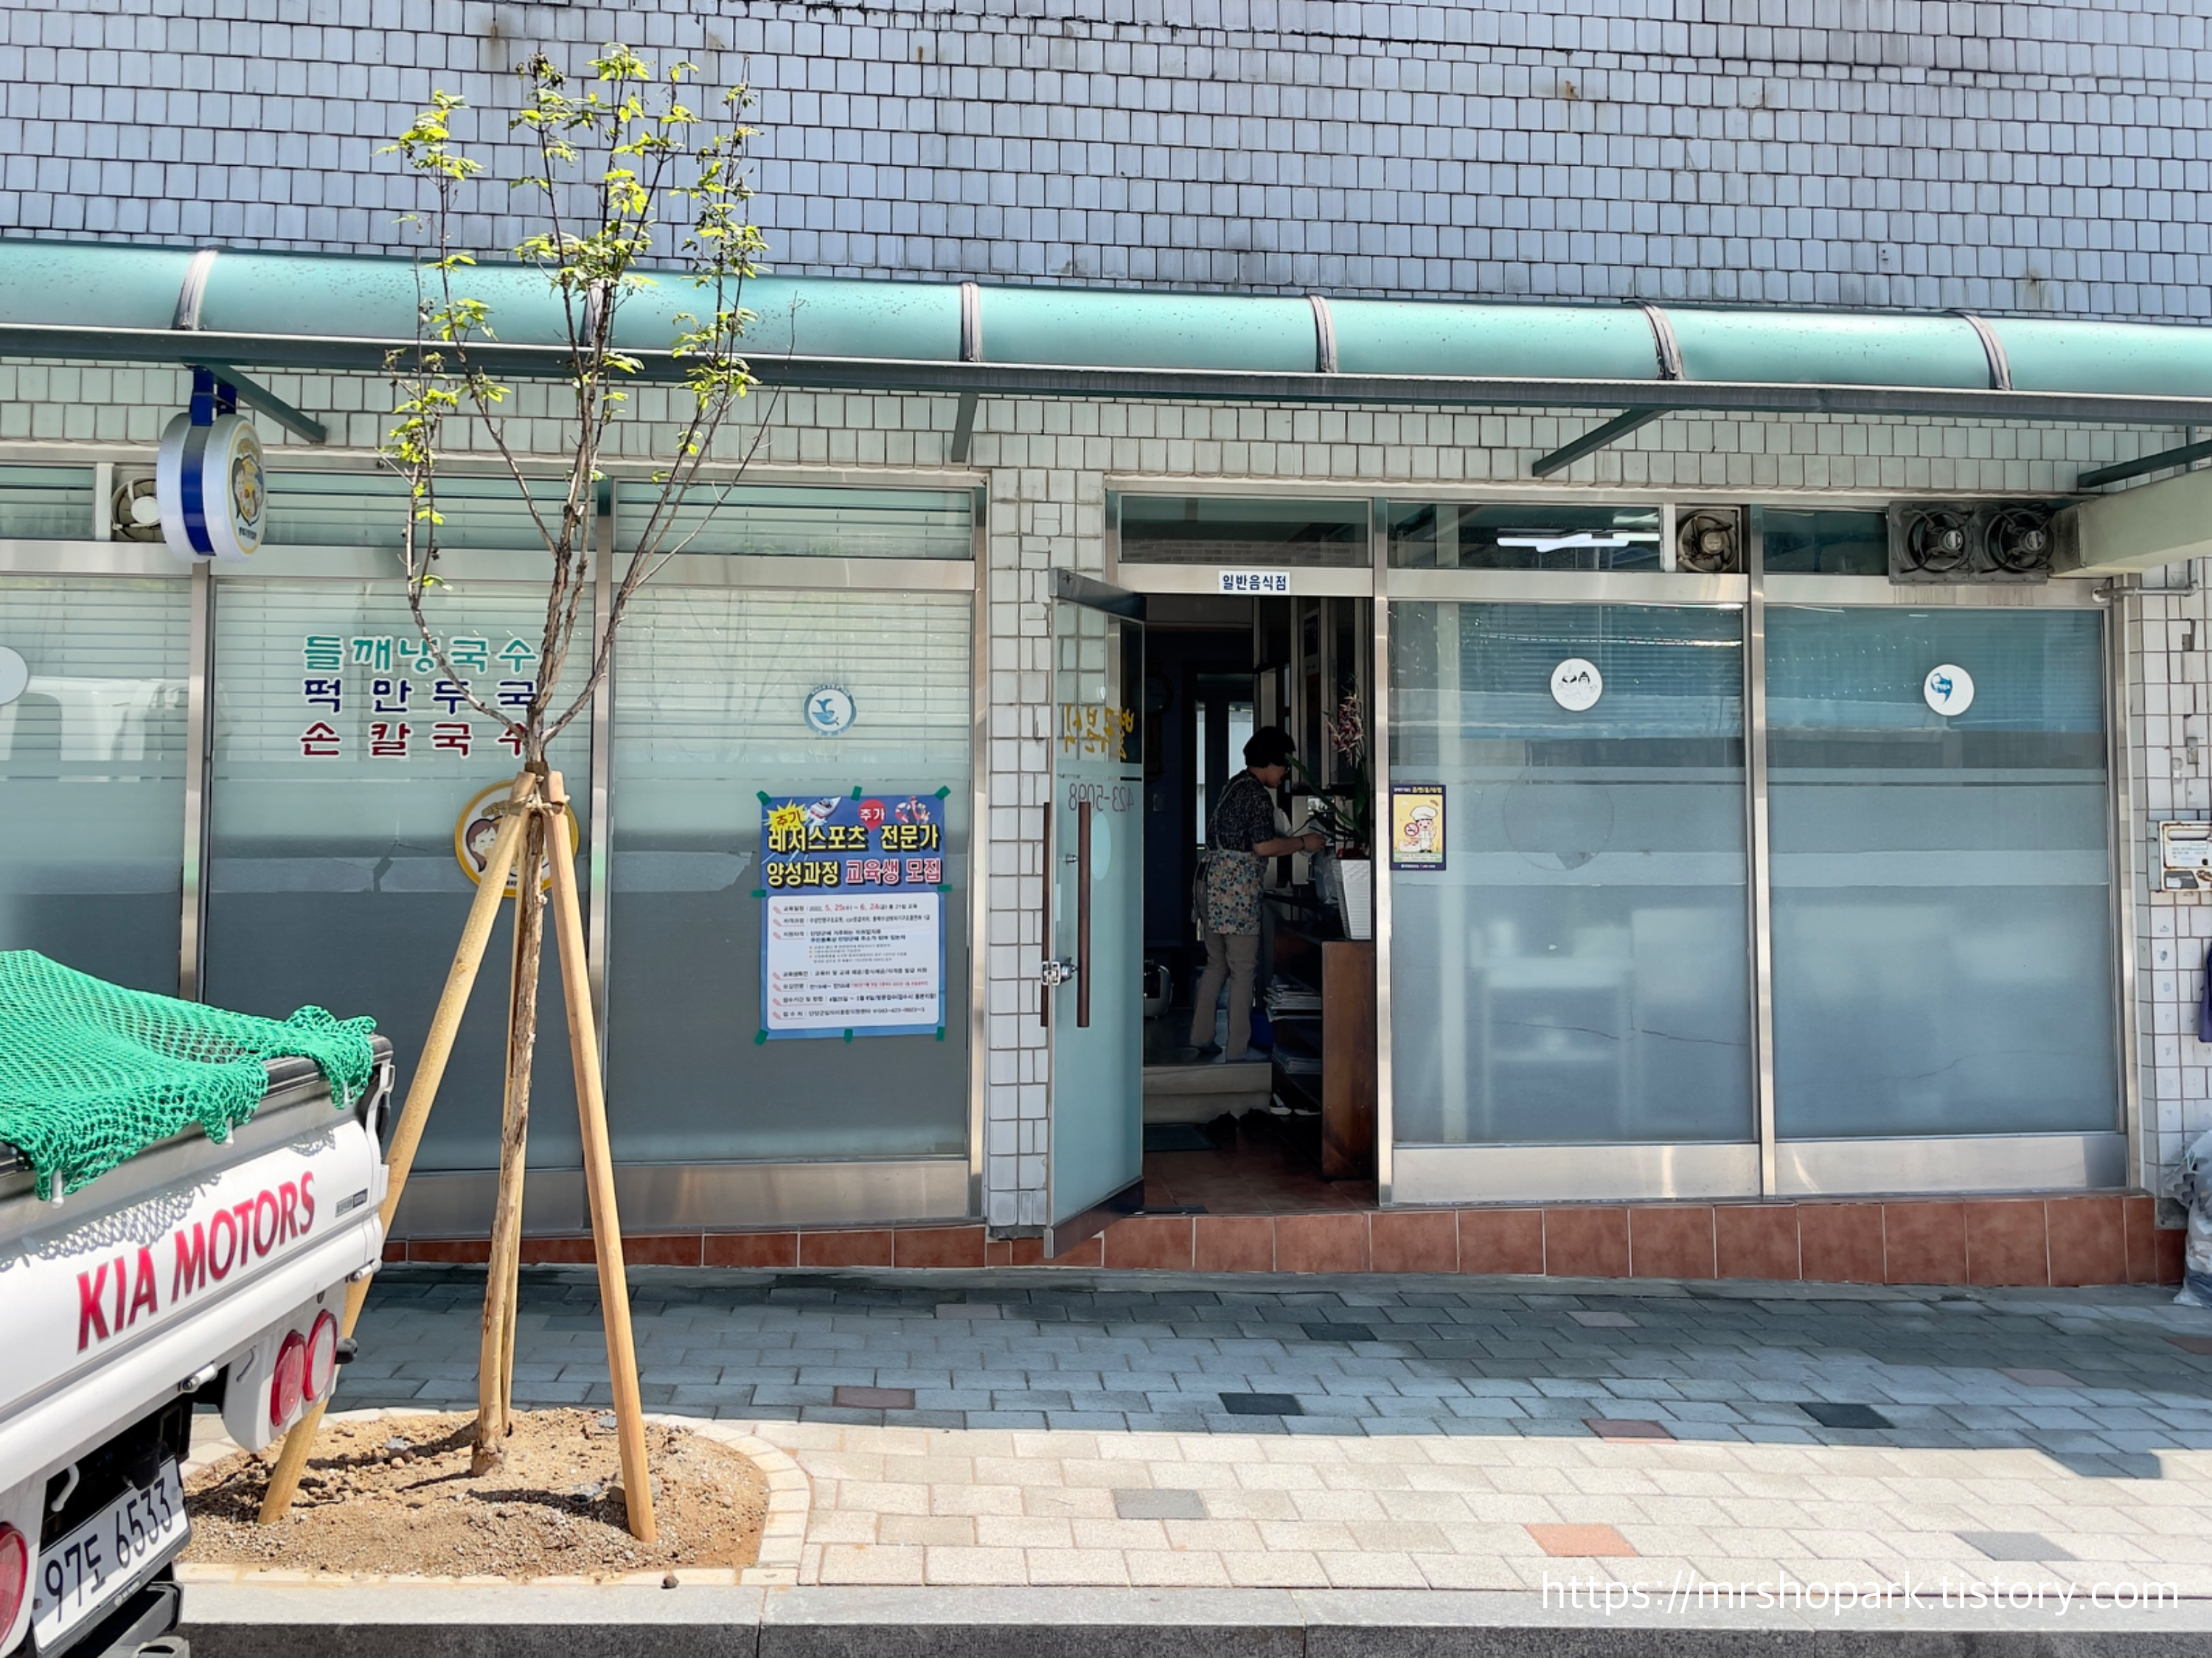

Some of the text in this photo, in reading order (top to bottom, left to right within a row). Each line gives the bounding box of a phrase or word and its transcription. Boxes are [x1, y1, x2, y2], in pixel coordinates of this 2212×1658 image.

[1222, 574, 1287, 591] 일반음식점
[304, 635, 537, 673] 들깨냉국수
[768, 824, 939, 851] 레저스포츠 전문가
[767, 858, 942, 885] 양성과정 교육생 모집
[76, 1170, 315, 1355] KIA MOTORS
[45, 1477, 173, 1623] 97도 6533
